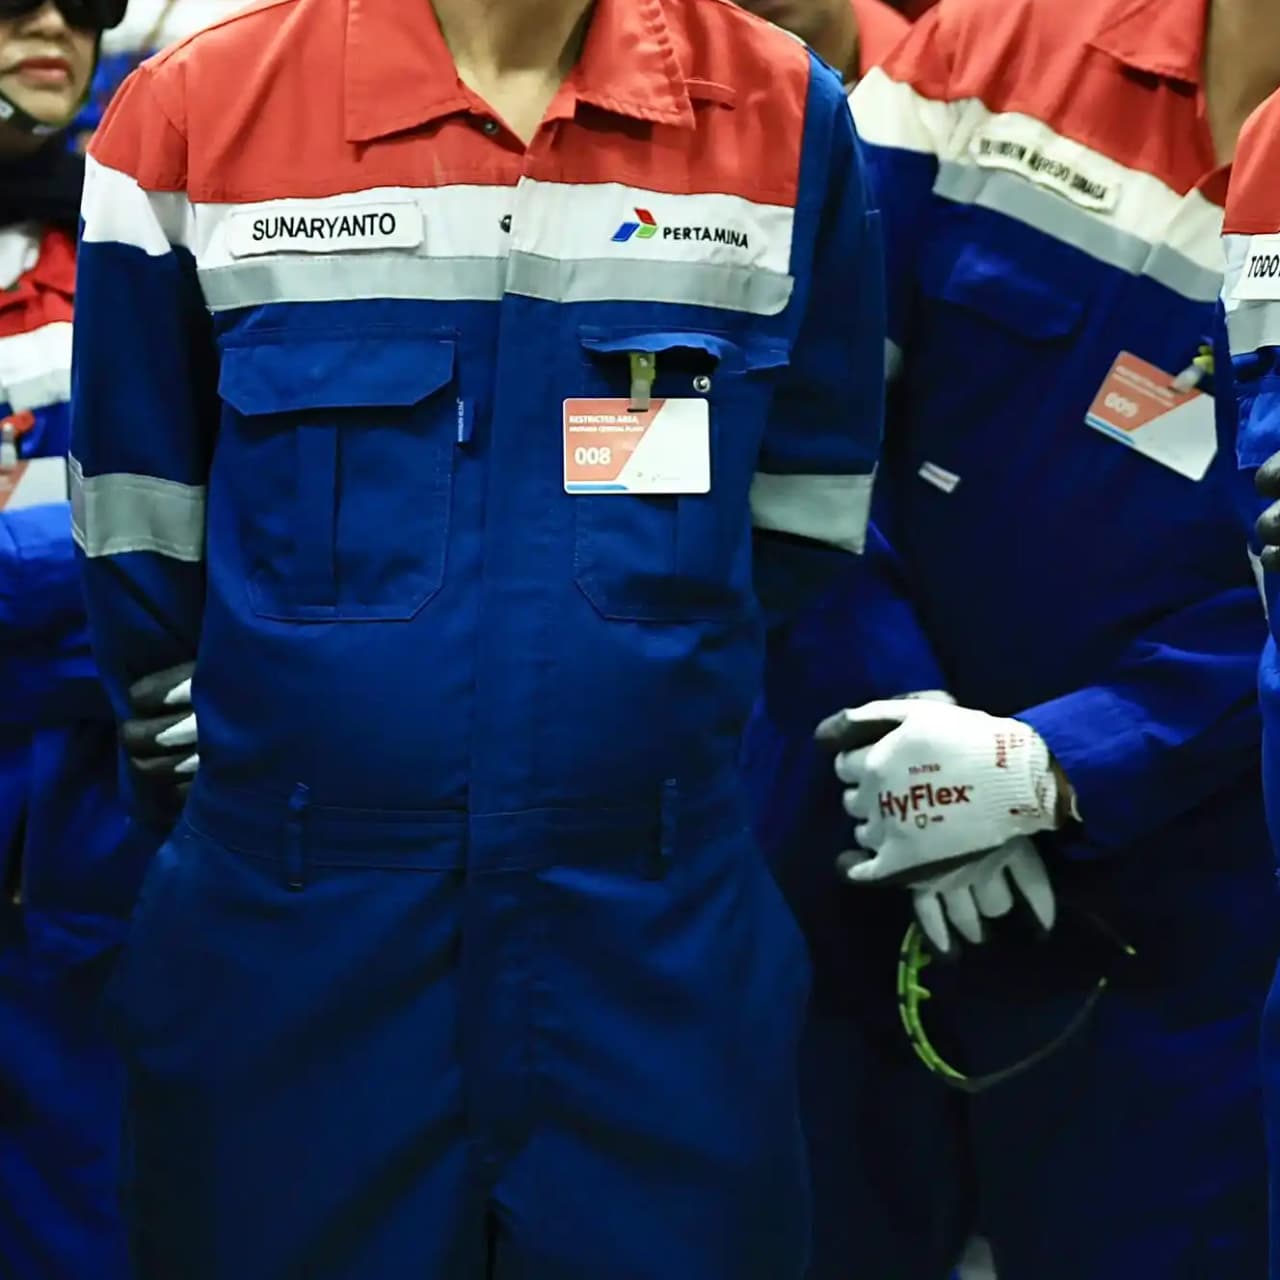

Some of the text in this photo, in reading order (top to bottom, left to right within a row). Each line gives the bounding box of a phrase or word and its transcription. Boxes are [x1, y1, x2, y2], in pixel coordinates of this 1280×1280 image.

[252, 212, 397, 241] SUNARYANTO
[663, 226, 749, 249] PERTAMINA
[574, 446, 612, 466] 008
[878, 782, 970, 823] HyFlex
